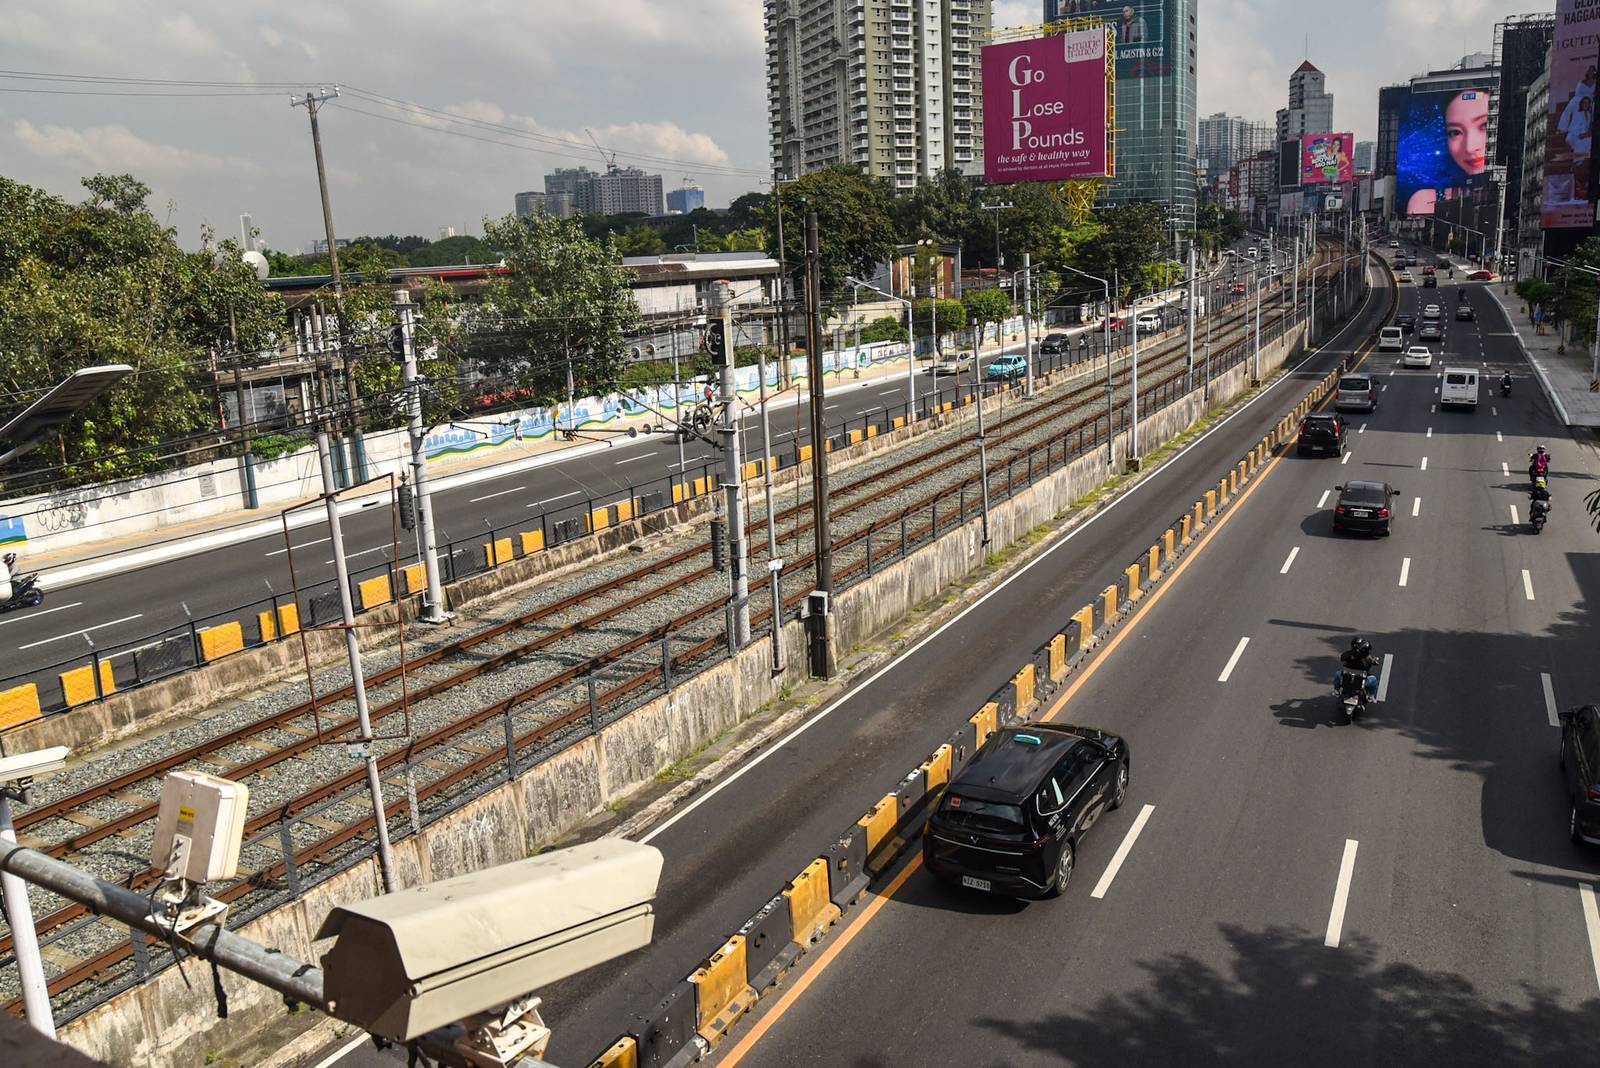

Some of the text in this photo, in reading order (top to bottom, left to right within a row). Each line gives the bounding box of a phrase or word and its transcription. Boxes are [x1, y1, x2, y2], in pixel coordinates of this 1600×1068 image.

[1120, 48, 1145, 59] AGUSTIN
[1008, 55, 1045, 86] Go
[1012, 89, 1064, 119] Lose
[1011, 120, 1085, 150] Pounds
[997, 149, 1090, 165] the safe & healthy way
